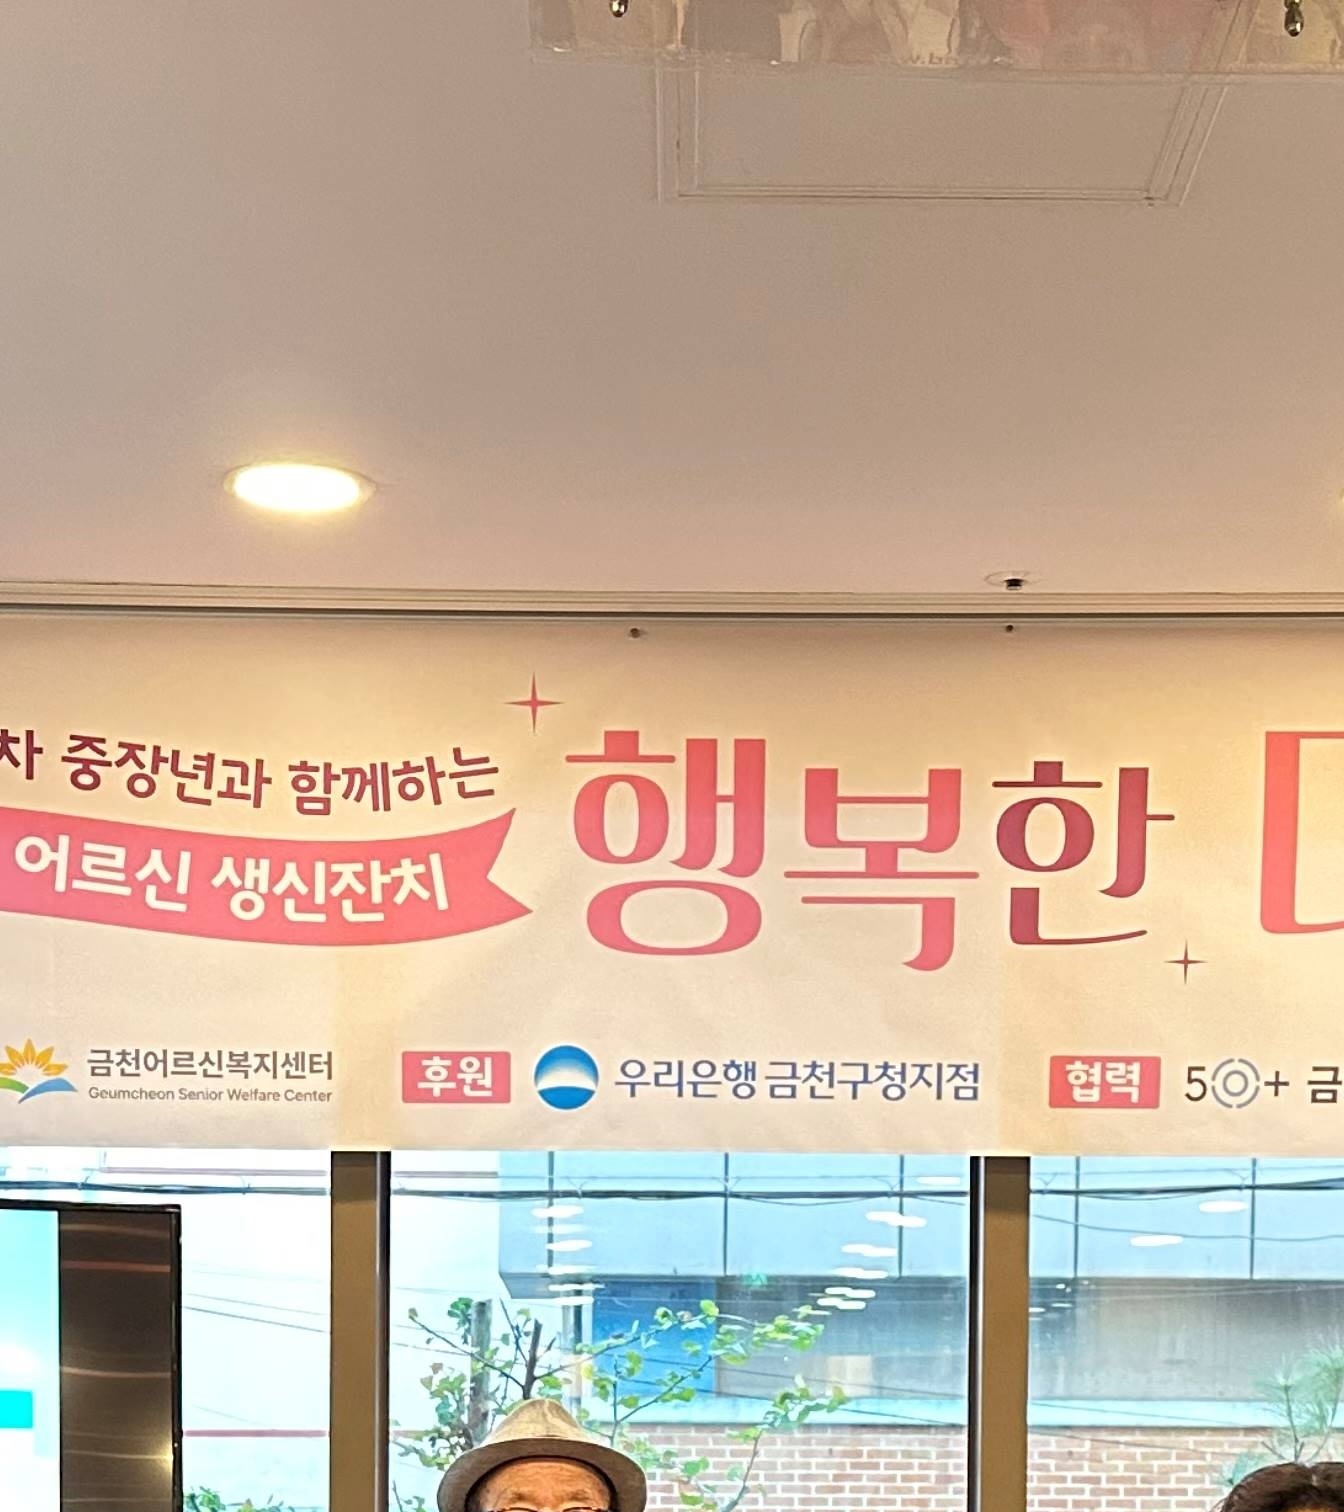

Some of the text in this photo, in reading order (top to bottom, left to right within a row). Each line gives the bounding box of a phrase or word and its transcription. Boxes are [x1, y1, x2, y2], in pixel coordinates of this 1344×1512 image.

[60, 733, 273, 808] 중장년과
[288, 746, 500, 816] 함께하는
[564, 729, 1176, 972] 행복한
[13, 832, 191, 911] 어르신
[210, 852, 450, 923] 생신잔치
[86, 1047, 334, 1081] 금천어르신복지센터
[415, 1054, 494, 1098] 후원
[614, 1059, 980, 1102] 우리은행 금천구청지점
[1064, 1061, 1142, 1103] 협력
[88, 1087, 333, 1103] Geumcheon Senior Welfare Center
